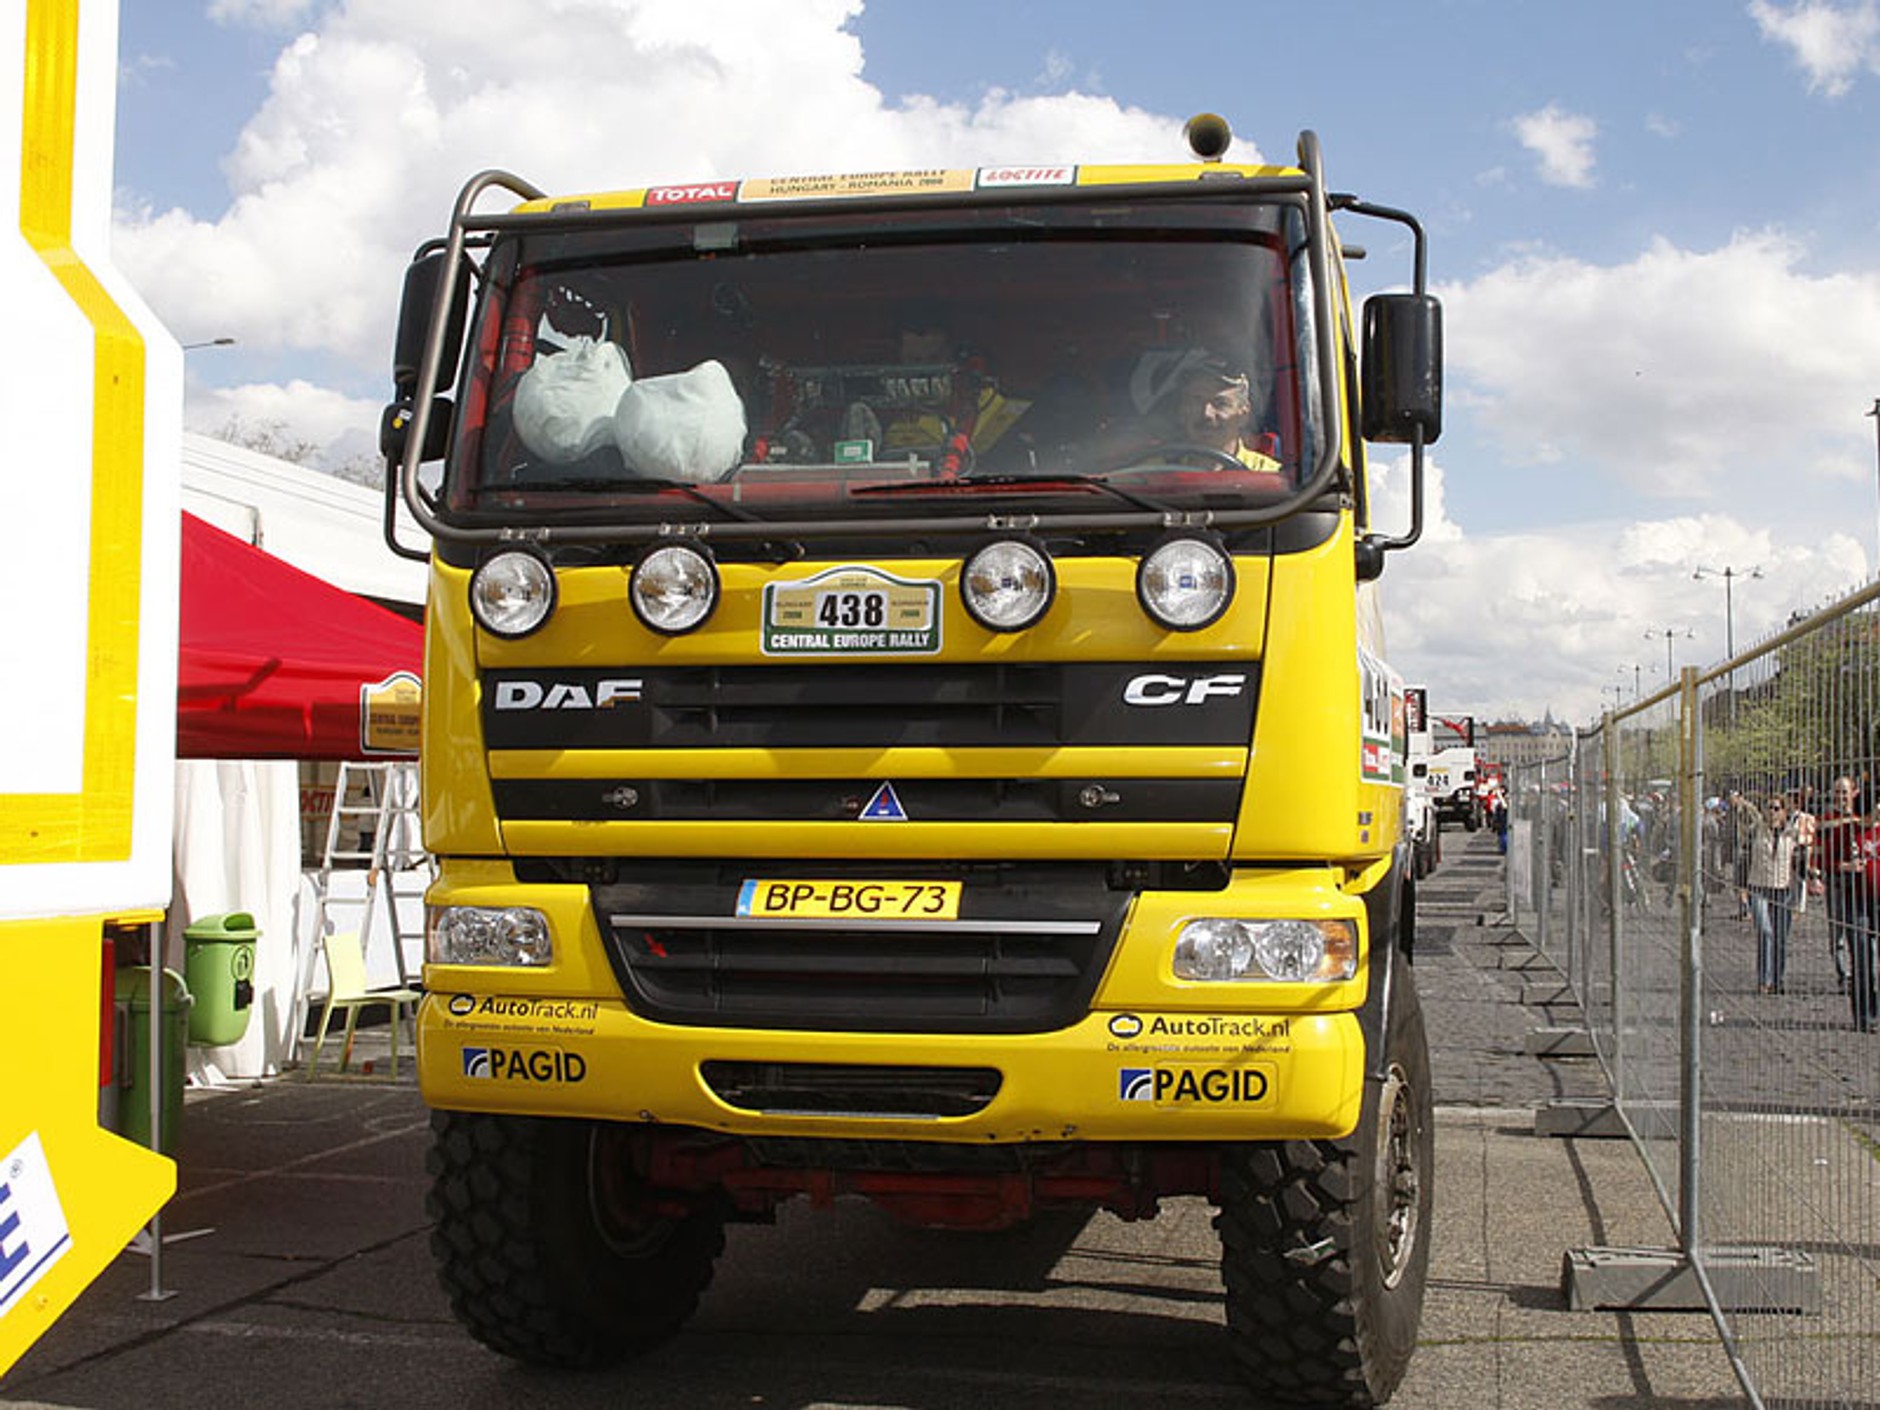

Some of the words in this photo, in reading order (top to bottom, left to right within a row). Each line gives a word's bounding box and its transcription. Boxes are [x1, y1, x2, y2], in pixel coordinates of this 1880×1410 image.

[848, 179, 912, 190] ROMANIA
[985, 168, 1067, 182] LOCTITE
[655, 186, 732, 201] TOTAL
[820, 593, 884, 627] 438
[771, 634, 830, 648] CENTRAL
[834, 633, 886, 648] EUROPE
[888, 633, 930, 647] RALLY
[495, 679, 644, 710] DAF
[1123, 674, 1247, 704] CF
[764, 883, 947, 914] BP-BG-73
[478, 997, 599, 1020] AutoTrack.nl
[1149, 1016, 1290, 1037] AutoTrack.nl
[490, 1048, 586, 1083] PAGID
[1155, 1069, 1268, 1102] PAGID
